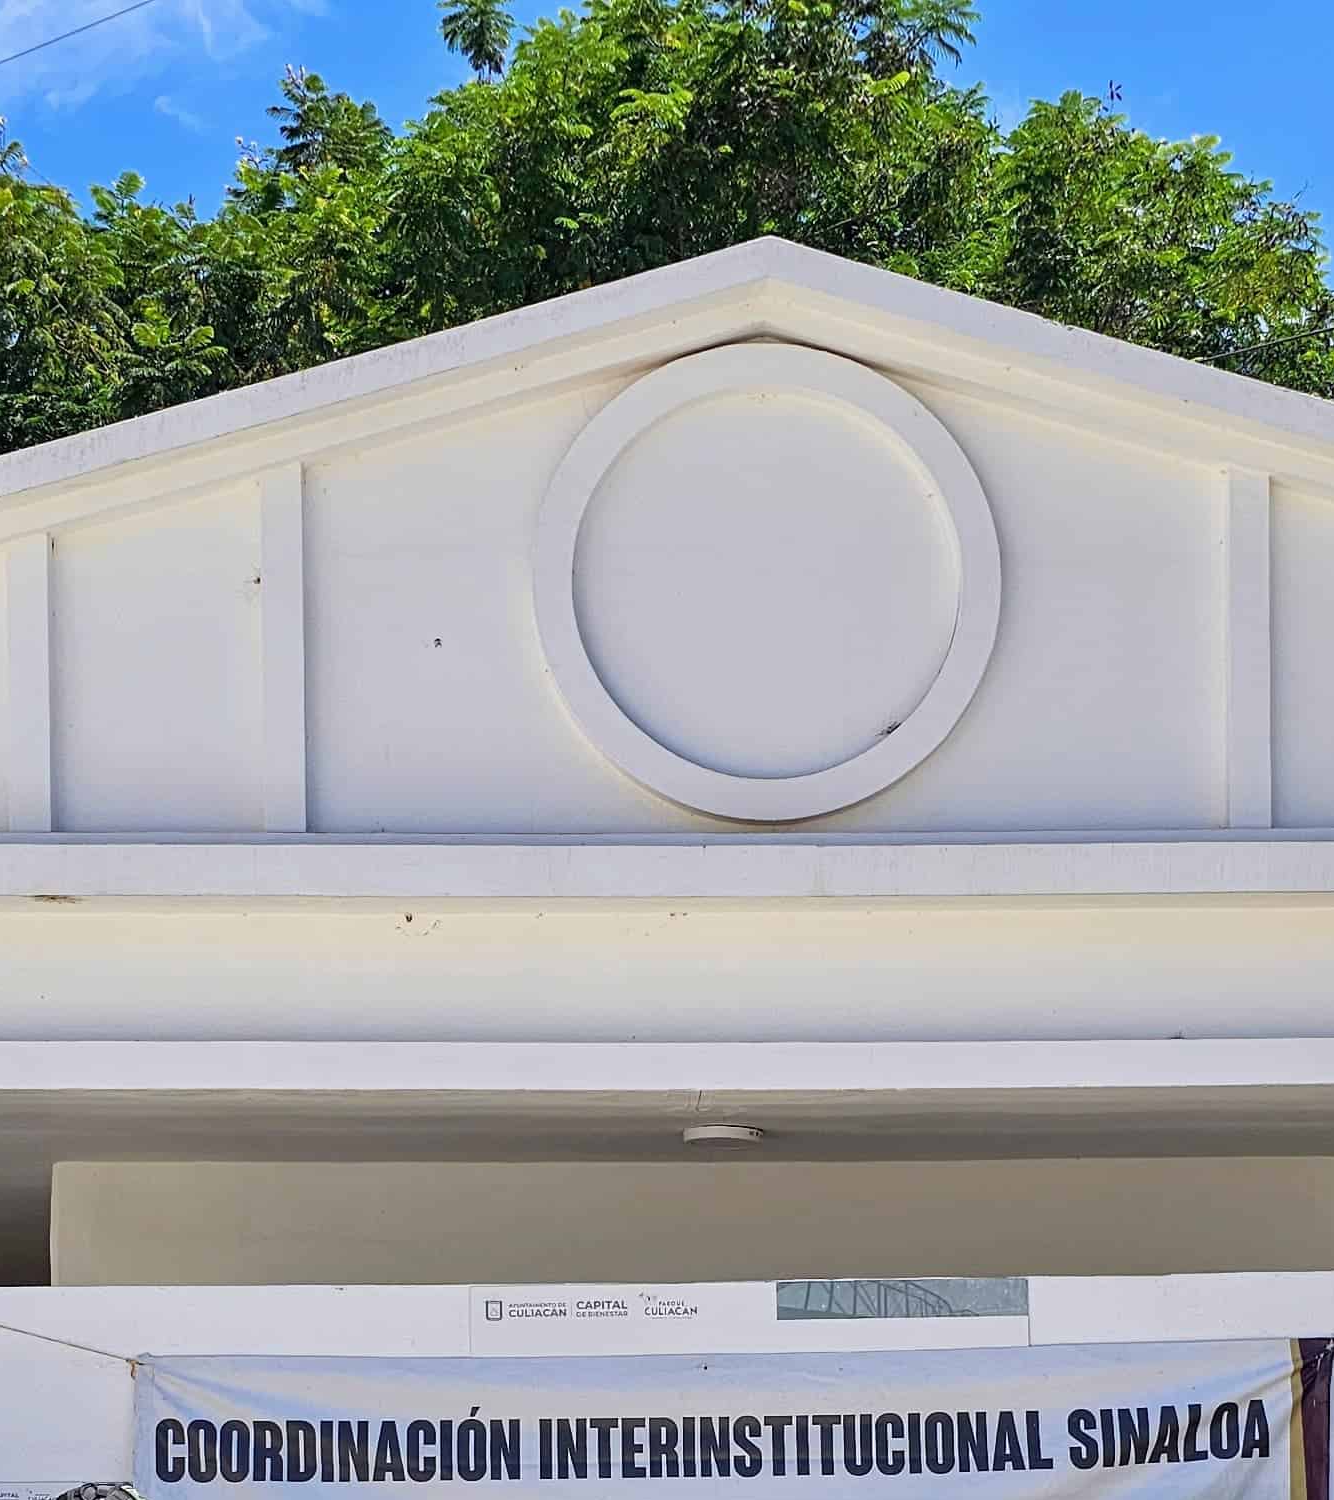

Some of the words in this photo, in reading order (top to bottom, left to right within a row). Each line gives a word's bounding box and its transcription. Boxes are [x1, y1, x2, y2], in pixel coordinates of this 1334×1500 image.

[576, 1300, 628, 1310] CAPITAL
[154, 1406, 522, 1484] COORDINACIÓN
[538, 1410, 1055, 1481] INTERINSTITUCIONAL
[1066, 1399, 1271, 1471] SINALOA
